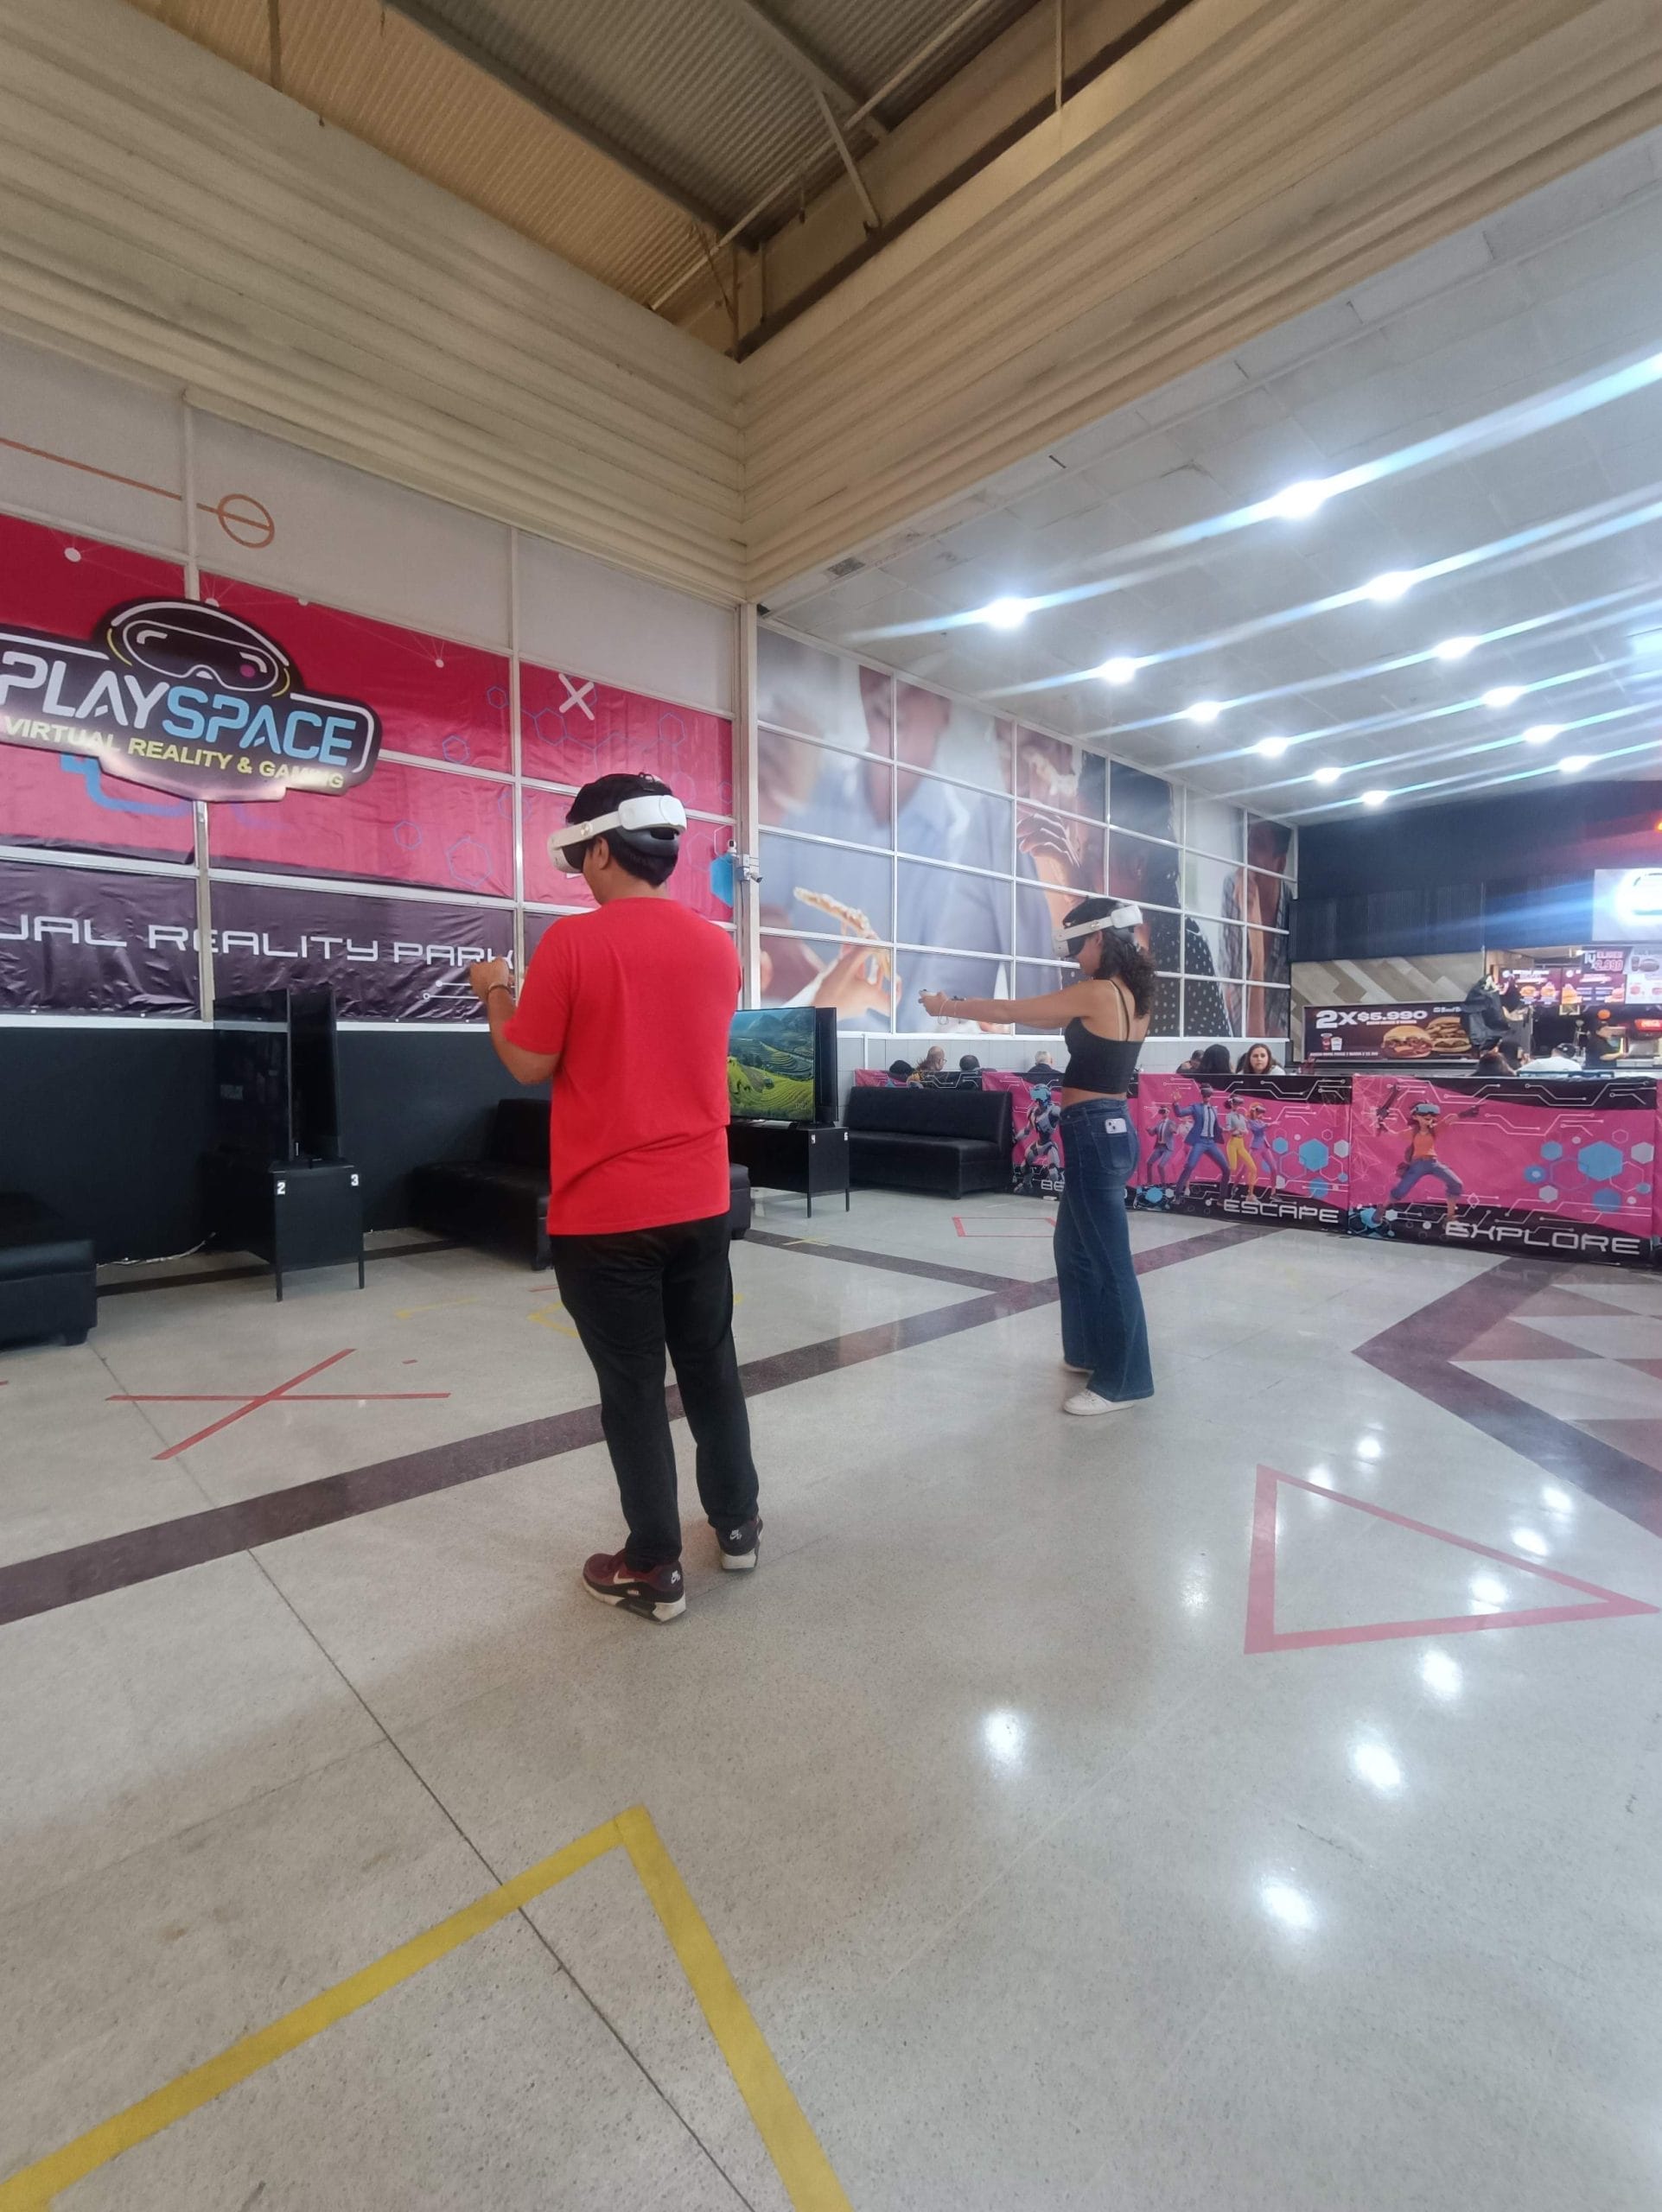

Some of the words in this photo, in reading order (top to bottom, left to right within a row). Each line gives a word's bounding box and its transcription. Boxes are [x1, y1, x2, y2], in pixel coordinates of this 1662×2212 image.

[0, 651, 356, 766] PLAYSPACE
[3, 715, 121, 752] VIRTUAL
[128, 738, 233, 770] REALITY
[237, 756, 253, 775] &
[148, 924, 379, 962] REALITY
[277, 1181, 286, 1195] 2
[351, 1173, 360, 1186] 3
[1223, 1198, 1340, 1224] ESCAPE
[1445, 1220, 1640, 1255] EXPLORE
